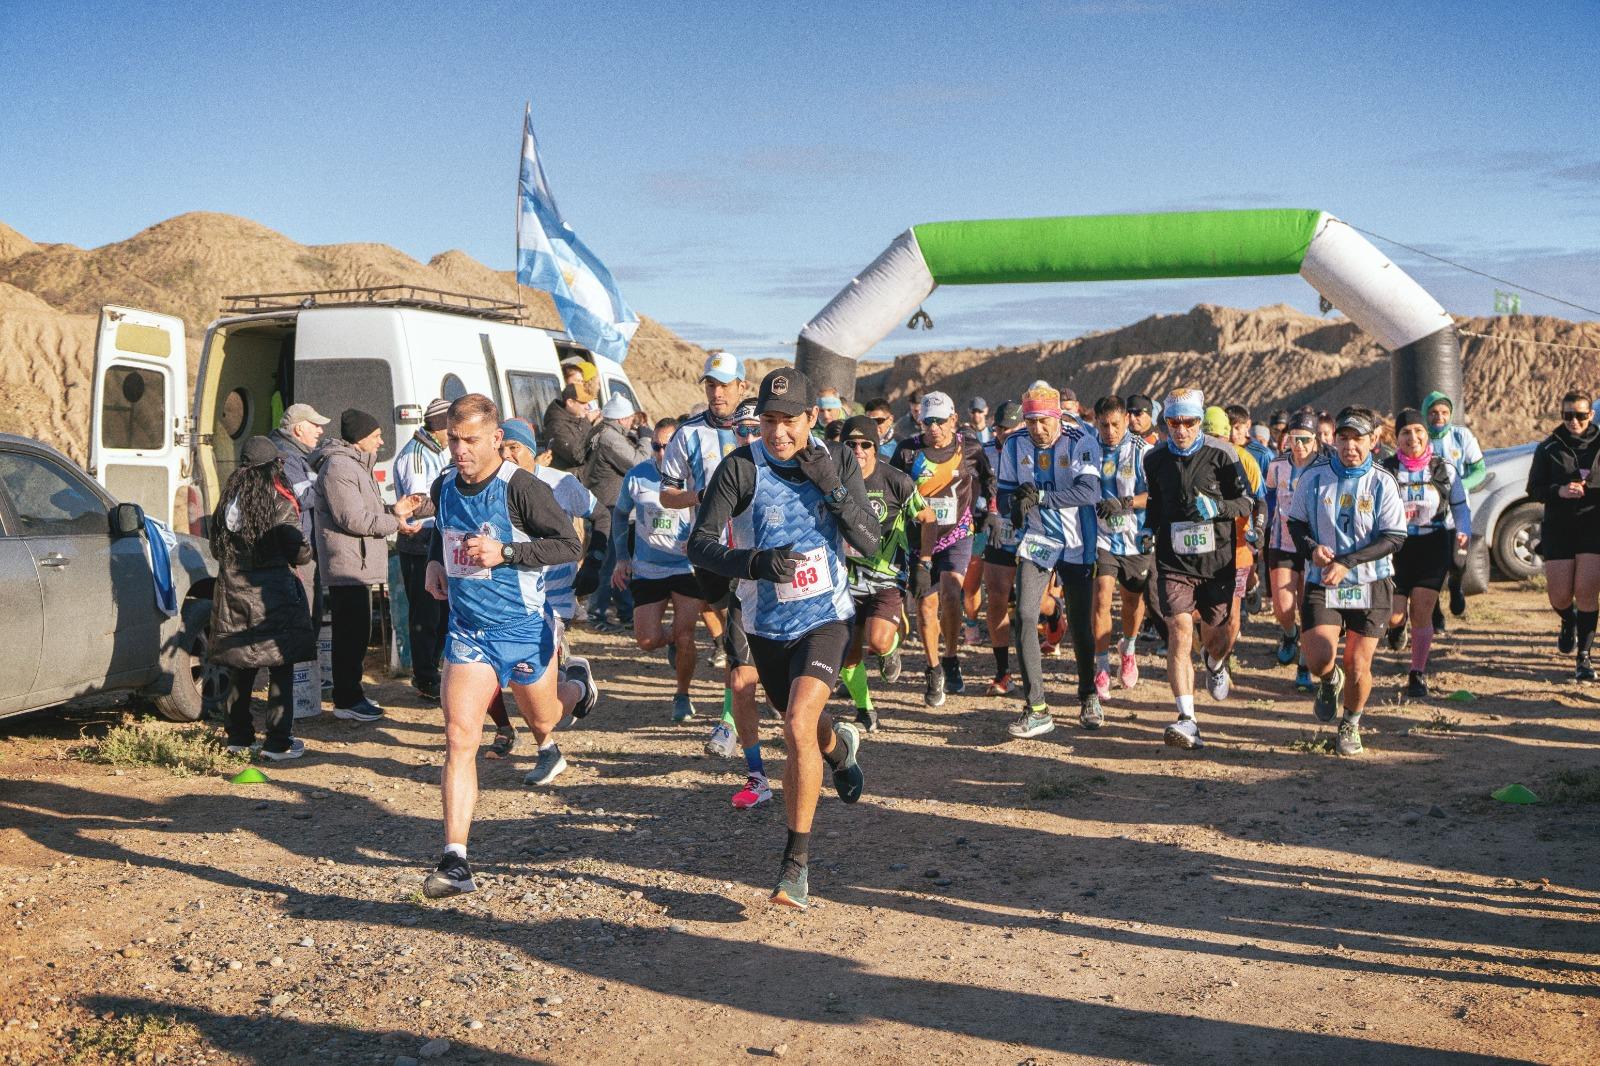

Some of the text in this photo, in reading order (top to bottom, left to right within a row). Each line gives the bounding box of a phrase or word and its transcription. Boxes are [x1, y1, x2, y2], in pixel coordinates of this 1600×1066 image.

[933, 508, 948, 519] 87
[652, 517, 672, 529] 083
[1183, 533, 1206, 547] 085
